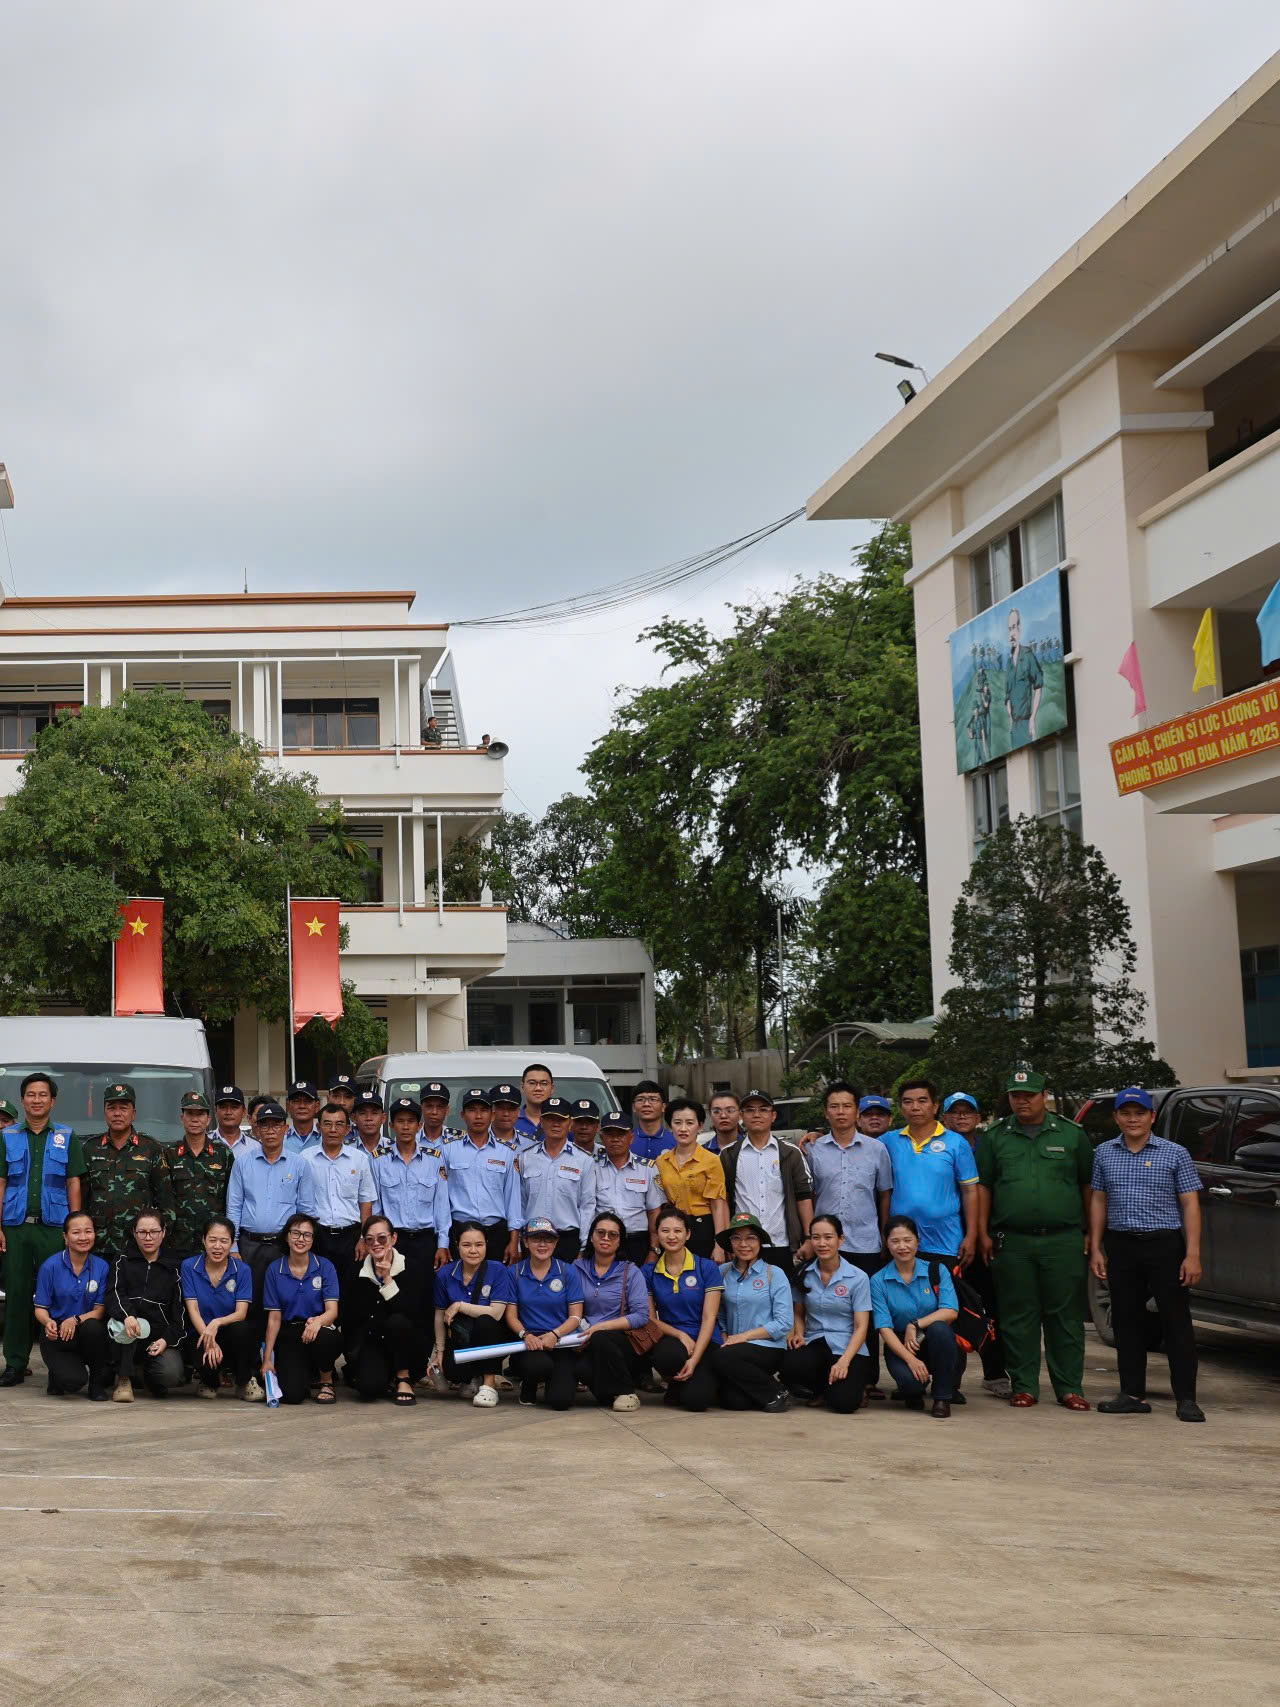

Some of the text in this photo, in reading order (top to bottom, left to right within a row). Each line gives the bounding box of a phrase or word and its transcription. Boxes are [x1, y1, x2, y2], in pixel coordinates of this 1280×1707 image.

[1115, 742, 1136, 765] CÁN
[1154, 723, 1185, 751] CHIẾN
[1185, 718, 1198, 740] SĨ
[1198, 713, 1220, 737] LỰC
[1222, 698, 1261, 727] LƯỢNG
[1261, 689, 1279, 713] VŨ
[1118, 721, 1280, 789] PHONG TRÀO THI ĐUA NĂM 2025
